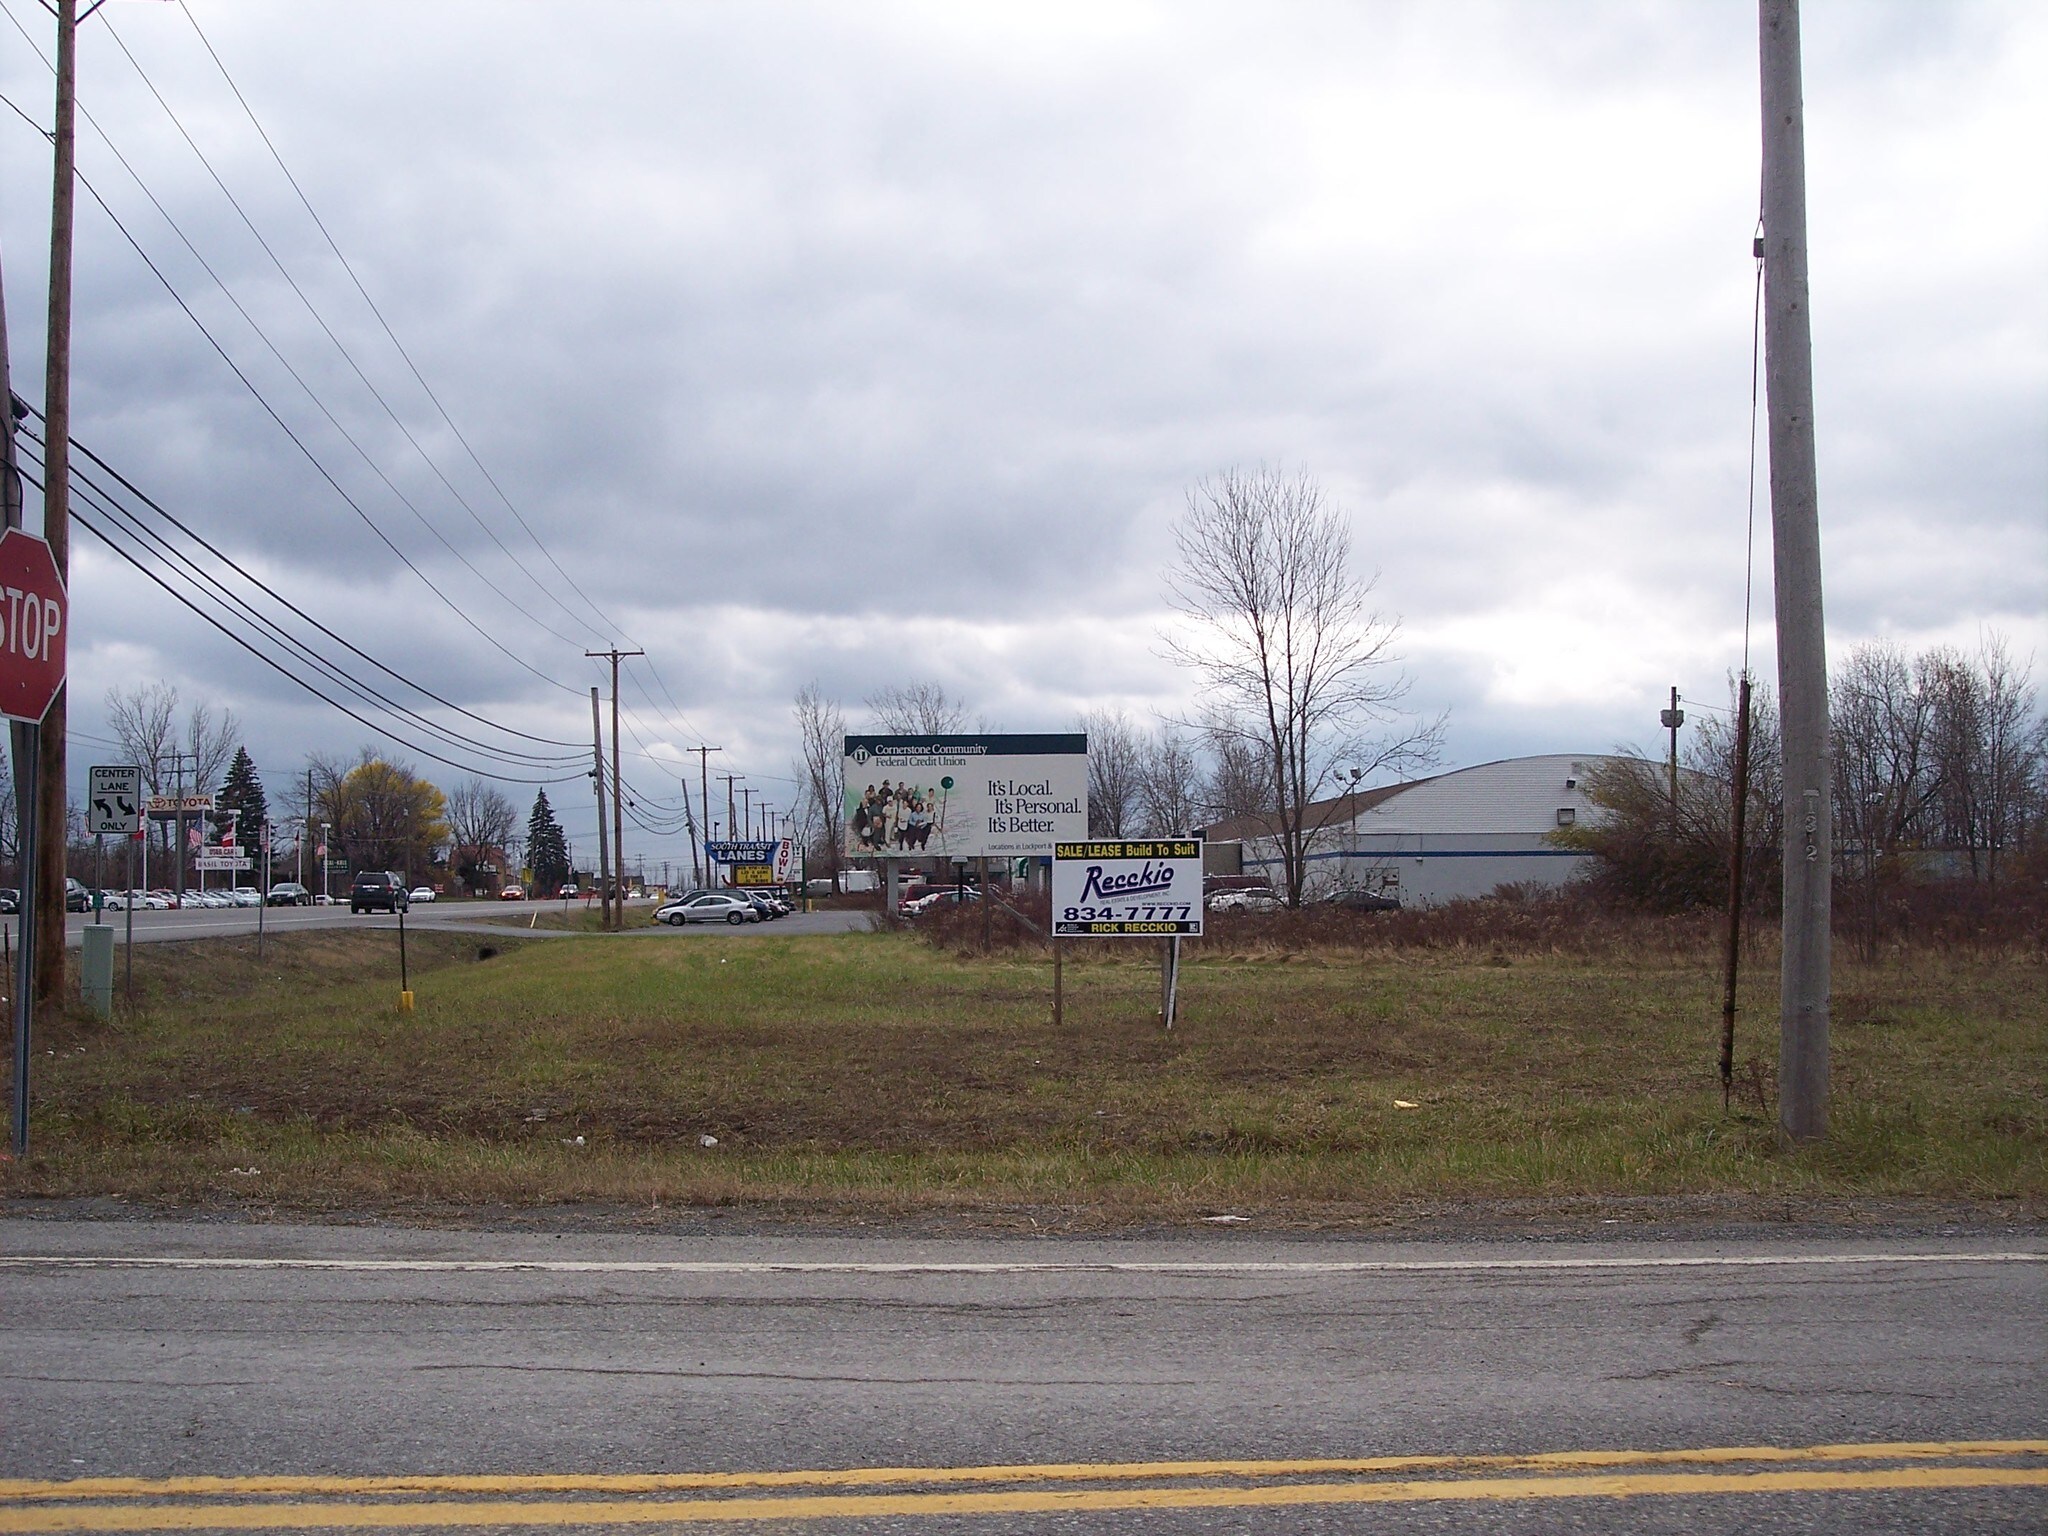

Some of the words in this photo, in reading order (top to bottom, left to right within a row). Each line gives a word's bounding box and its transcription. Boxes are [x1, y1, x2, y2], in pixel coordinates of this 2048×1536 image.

[0, 584, 61, 661] TOP
[875, 744, 931, 755] Cornerstone
[932, 743, 988, 756] Community
[875, 756, 908, 767] Federal
[909, 756, 937, 766] Credit
[938, 756, 966, 766] Union
[95, 769, 135, 778] CENTER
[101, 782, 129, 791] LANE
[988, 780, 1006, 796] It's
[1009, 780, 1053, 796] Local.
[995, 798, 1013, 814] It's
[1016, 798, 1082, 814] Personal.
[100, 822, 127, 831] ONLY
[988, 817, 1006, 833] It's
[1009, 816, 1055, 833] Better.
[711, 843, 738, 851] SOUTH
[739, 843, 772, 851] TRANSIT
[1022, 843, 1047, 851] Lockport
[1057, 844, 1122, 858] SALE/LEASE
[1126, 844, 1153, 857] Build
[1156, 844, 1169, 856] To
[1174, 843, 1195, 855] Suit
[717, 850, 766, 861] LANES
[220, 860, 247, 868] TOYOTA
[1079, 860, 1175, 904] Recckio
[1063, 906, 1191, 921] 834-7777
[1091, 923, 1119, 933] RICK
[1124, 922, 1177, 933] RECCKIO
